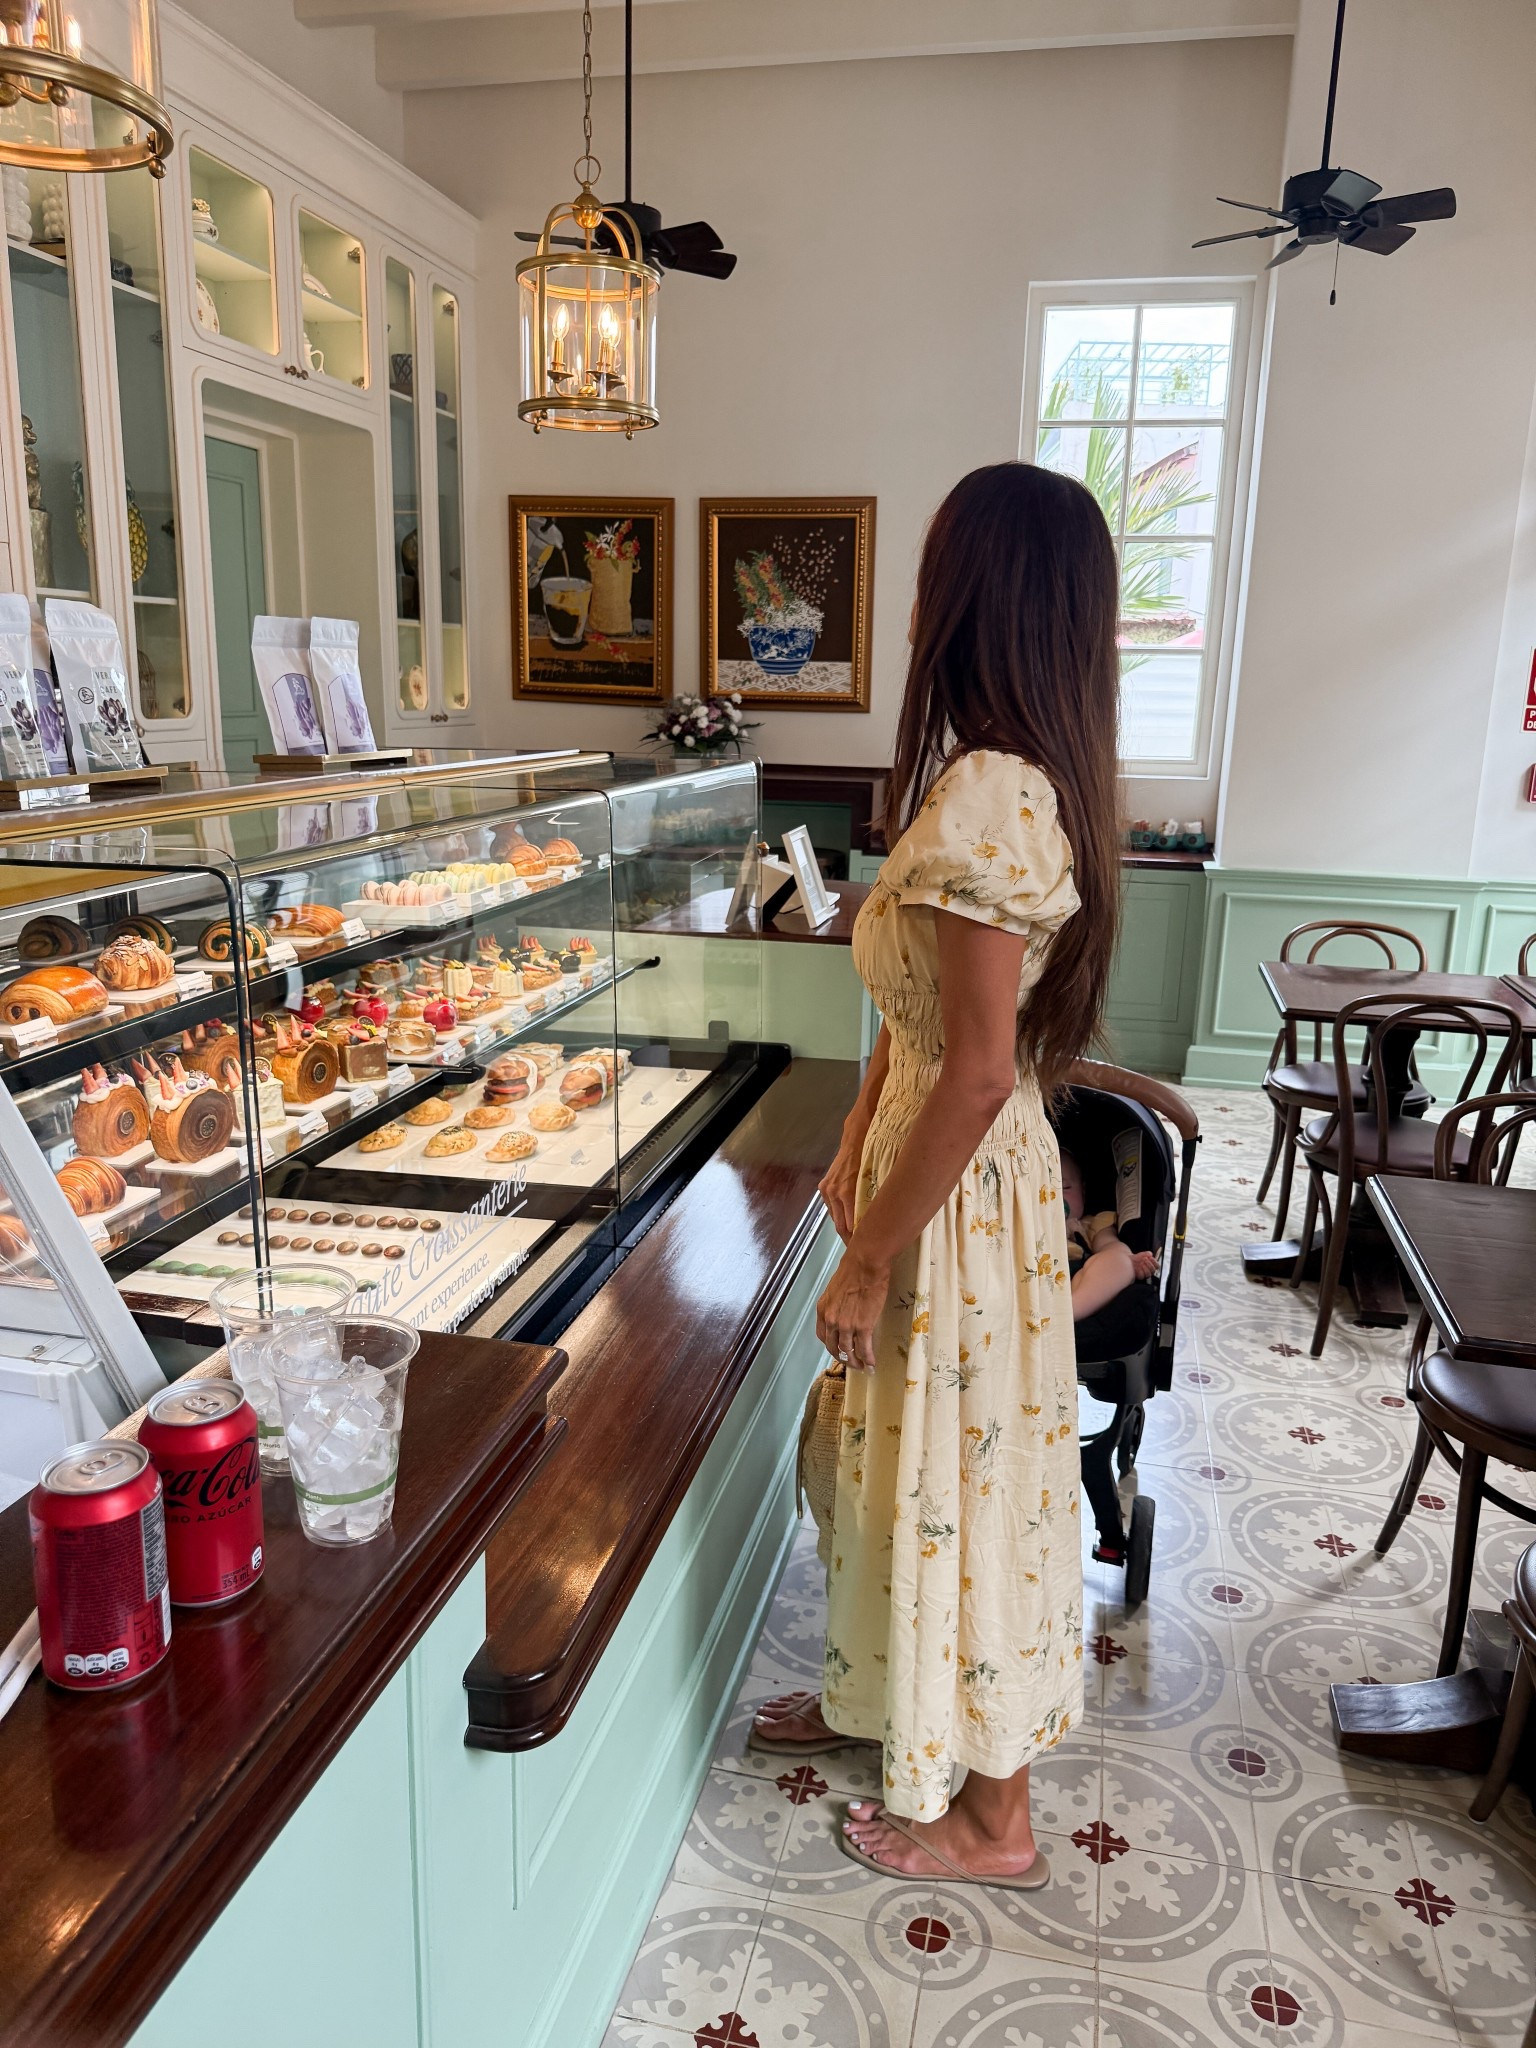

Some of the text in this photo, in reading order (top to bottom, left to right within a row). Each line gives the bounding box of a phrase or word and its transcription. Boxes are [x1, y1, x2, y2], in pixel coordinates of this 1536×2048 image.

[350, 1162, 528, 1315] aute Croissanterie
[431, 1253, 490, 1313] experience.
[197, 1496, 252, 1521] AZÚCAR
[223, 1575, 238, 1589] 354
